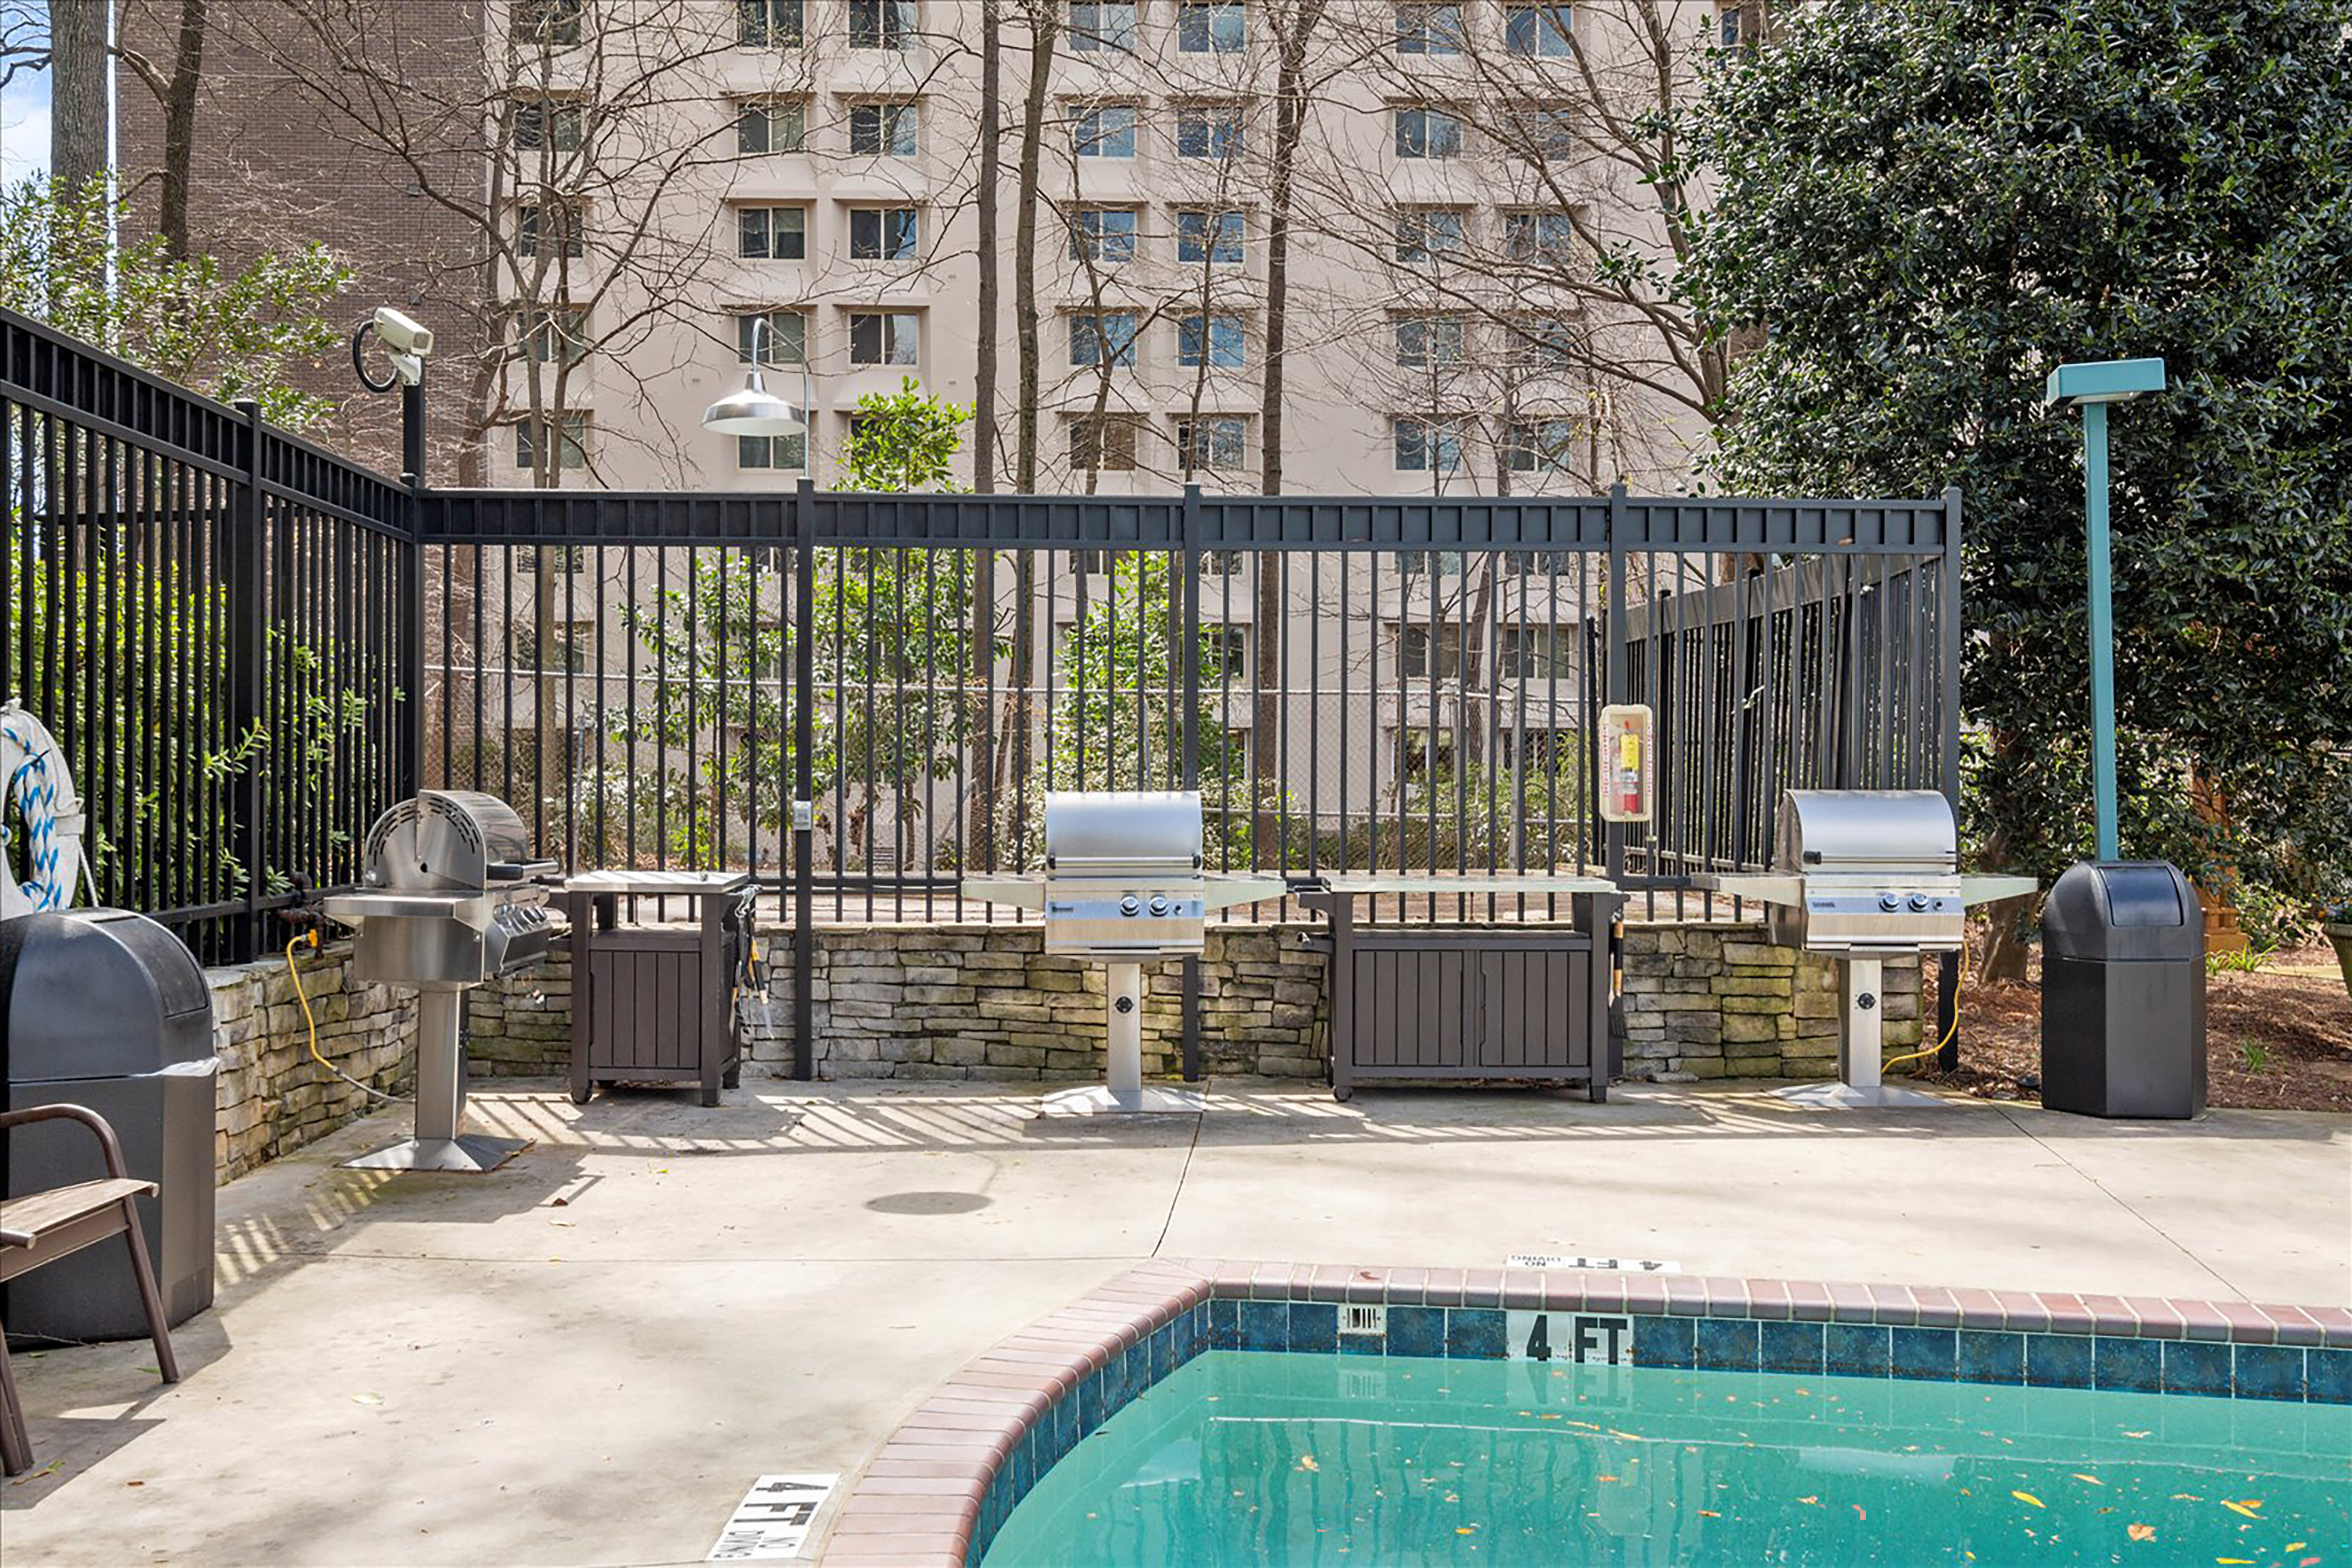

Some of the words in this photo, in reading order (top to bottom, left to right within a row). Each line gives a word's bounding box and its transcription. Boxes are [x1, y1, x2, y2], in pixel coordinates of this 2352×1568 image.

[1568, 1257, 1618, 1269] FT
[1638, 1260, 1663, 1271] 4
[1526, 1314, 1551, 1361] 4
[1575, 1316, 1628, 1365] FT
[755, 1482, 829, 1492] 4
[732, 1501, 818, 1526] FT
